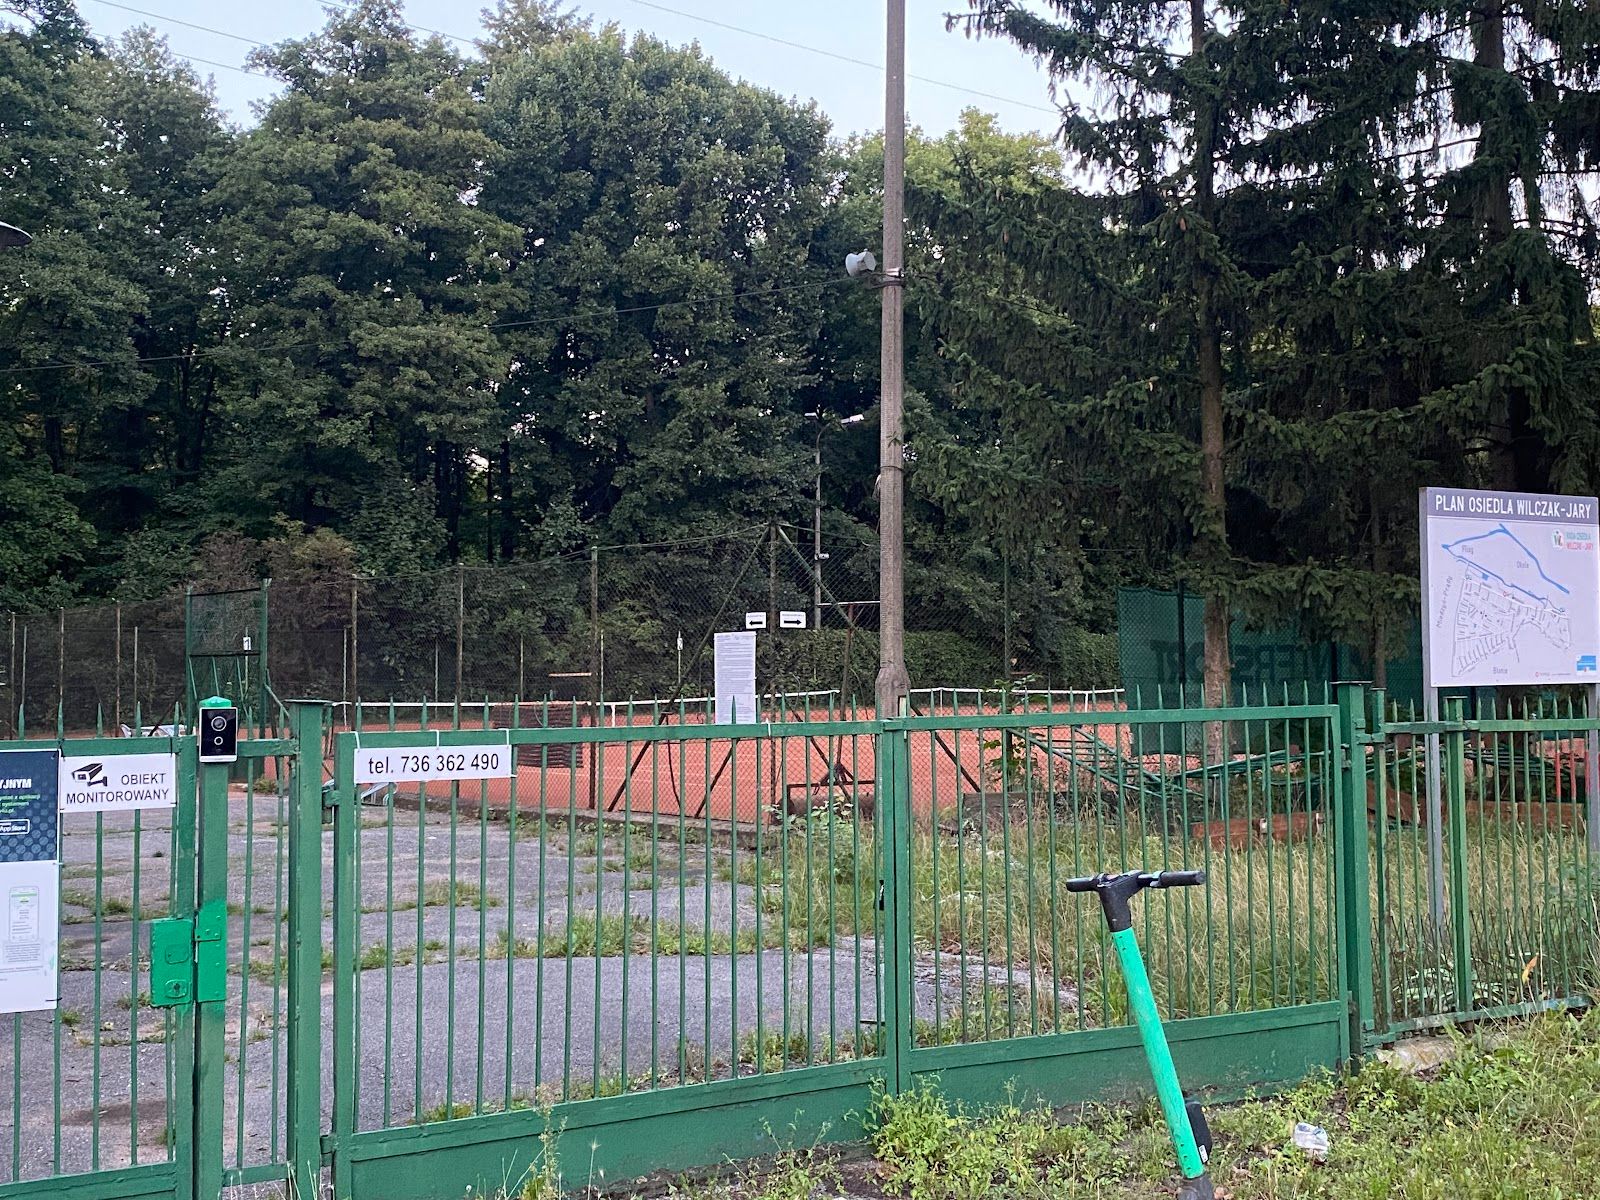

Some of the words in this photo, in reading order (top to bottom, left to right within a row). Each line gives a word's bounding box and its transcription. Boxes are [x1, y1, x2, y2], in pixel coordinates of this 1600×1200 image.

[1435, 495, 1465, 512] PLAN
[1468, 497, 1514, 515] OSIEDLA
[1517, 499, 1592, 519] WILCZAK-JARY
[368, 756, 394, 774] tel.
[401, 755, 430, 773] 736
[436, 754, 465, 771] 362
[471, 753, 499, 770] 490
[121, 773, 167, 786] OBIEKT
[66, 788, 169, 805] MONITOROWANY
